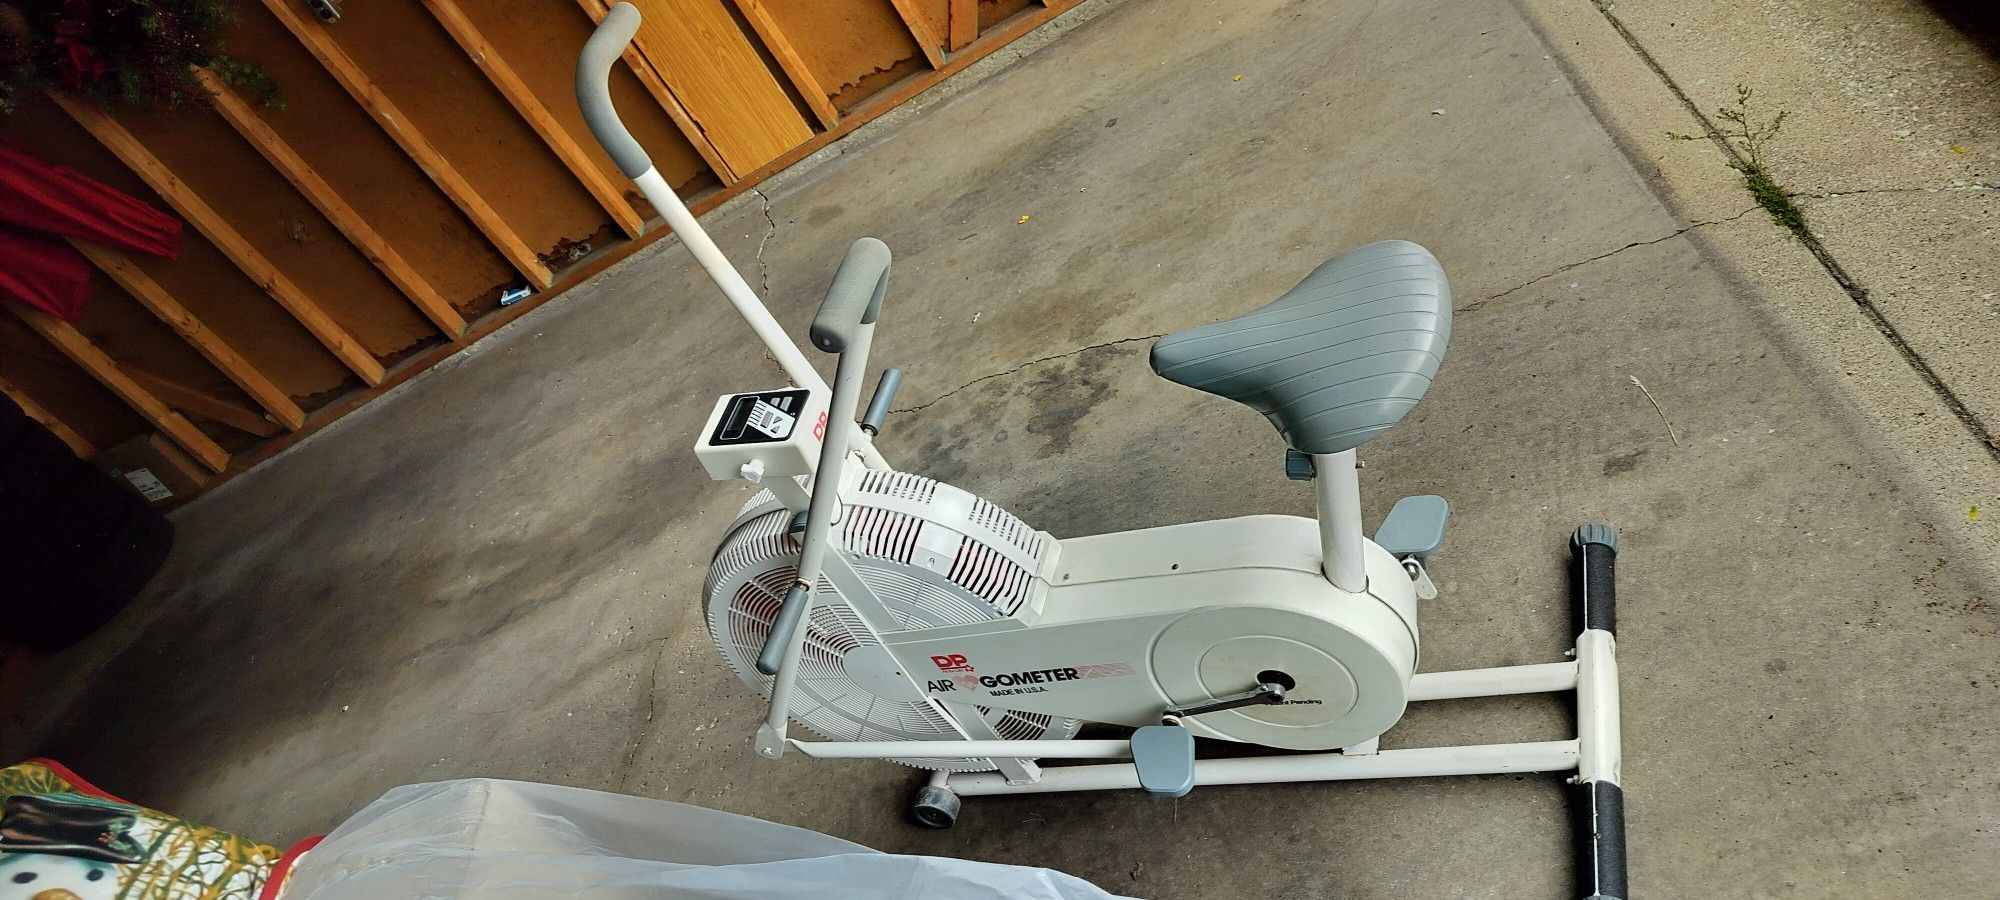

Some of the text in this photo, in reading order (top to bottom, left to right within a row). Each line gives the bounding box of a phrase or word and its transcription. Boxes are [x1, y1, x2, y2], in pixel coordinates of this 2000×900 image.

[930, 654, 968, 668] DP
[927, 667, 1081, 692] AIR GOMETER
[989, 688, 1015, 697] MADE
[1014, 687, 1025, 695] IN
